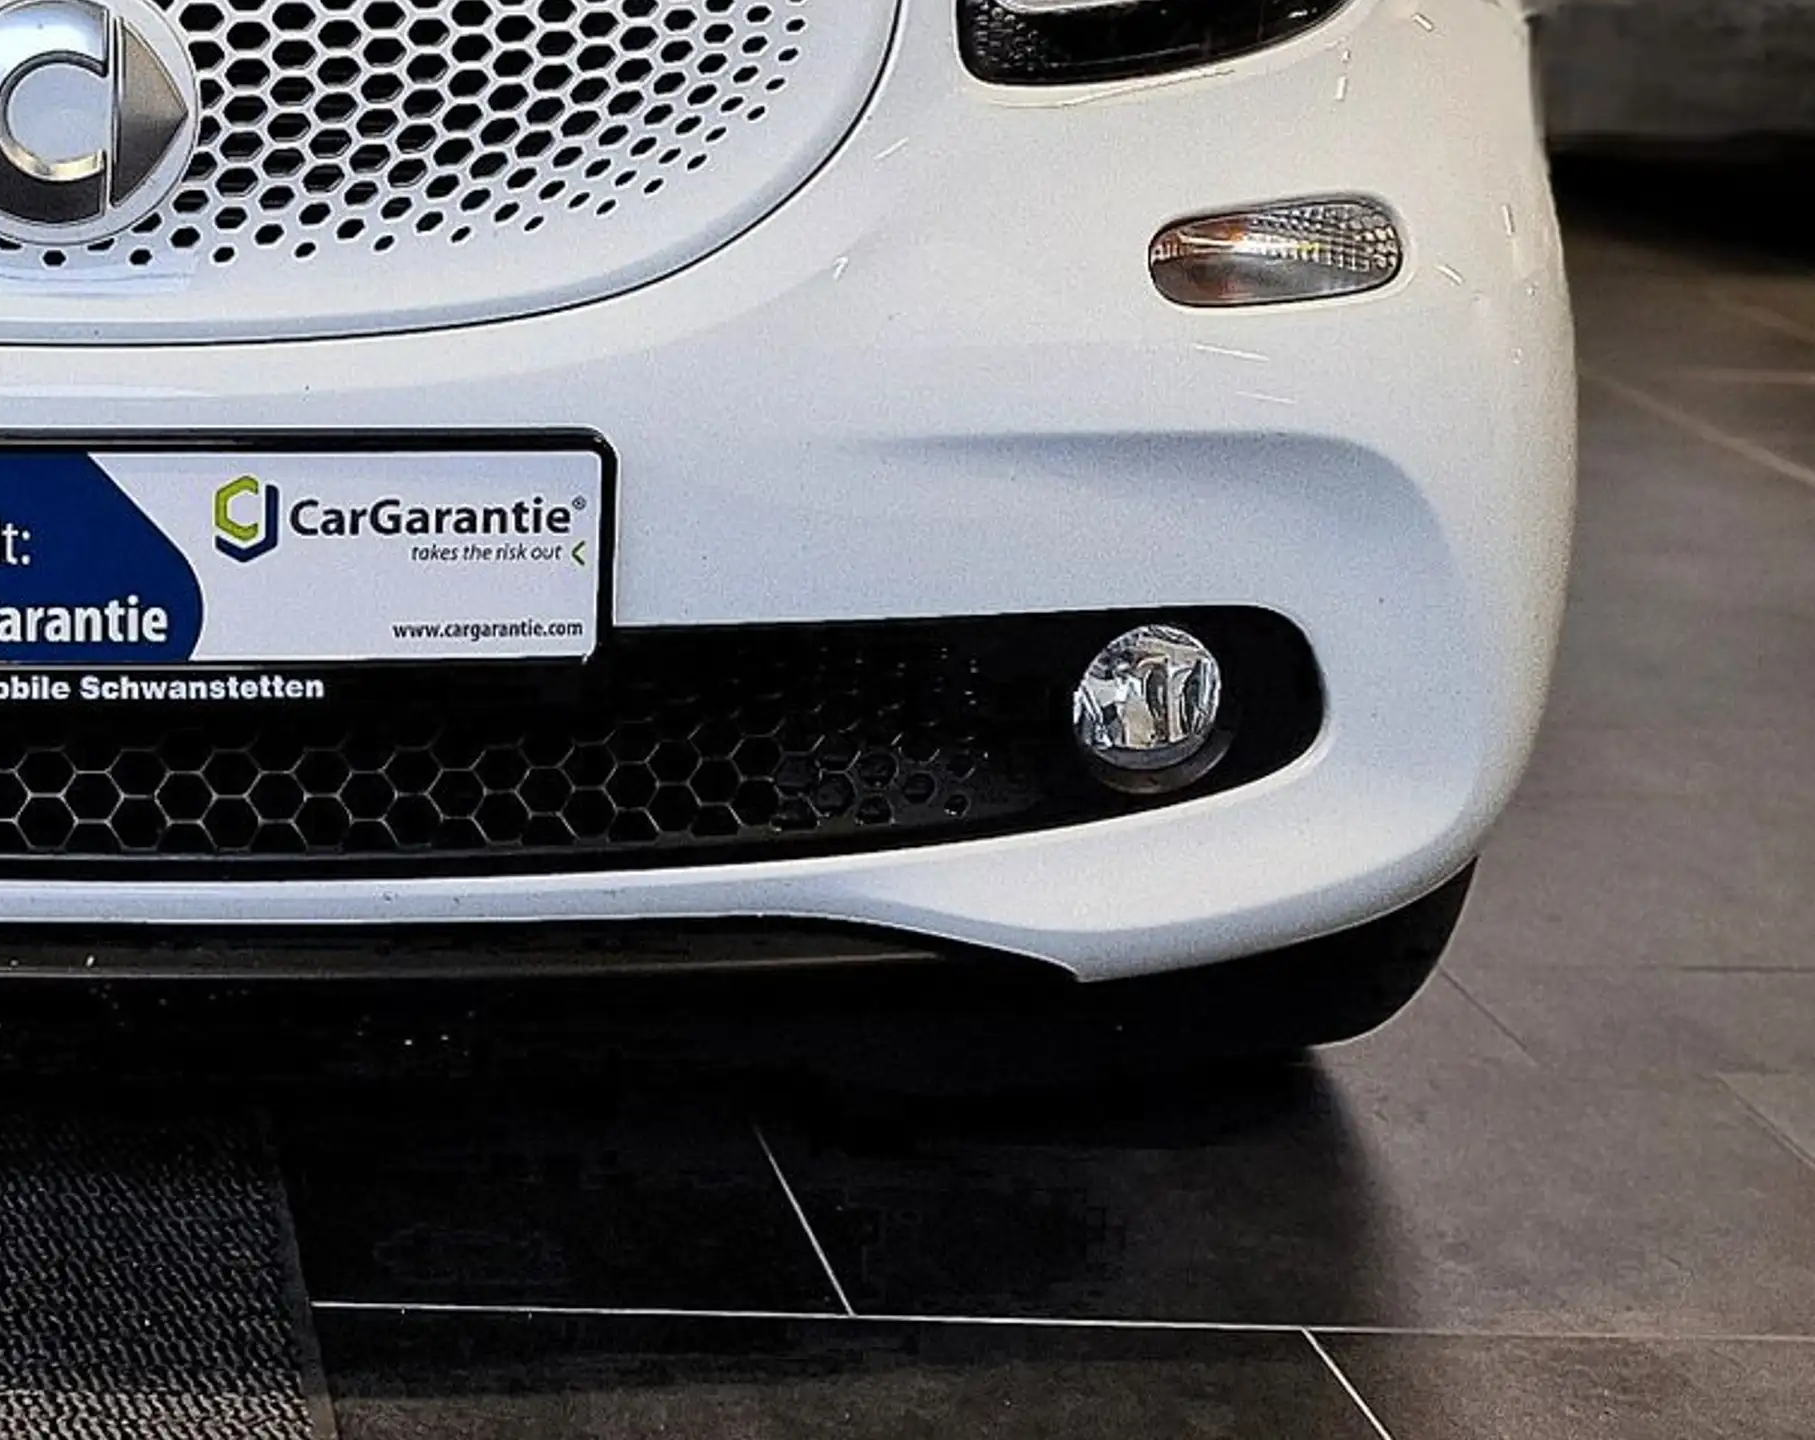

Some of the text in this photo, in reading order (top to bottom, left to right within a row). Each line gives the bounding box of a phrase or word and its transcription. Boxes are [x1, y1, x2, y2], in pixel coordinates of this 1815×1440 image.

[411, 543, 563, 561] takes the risk out
[392, 619, 583, 642] www.cargarantie.com
[80, 674, 324, 700] Schwanstetten
